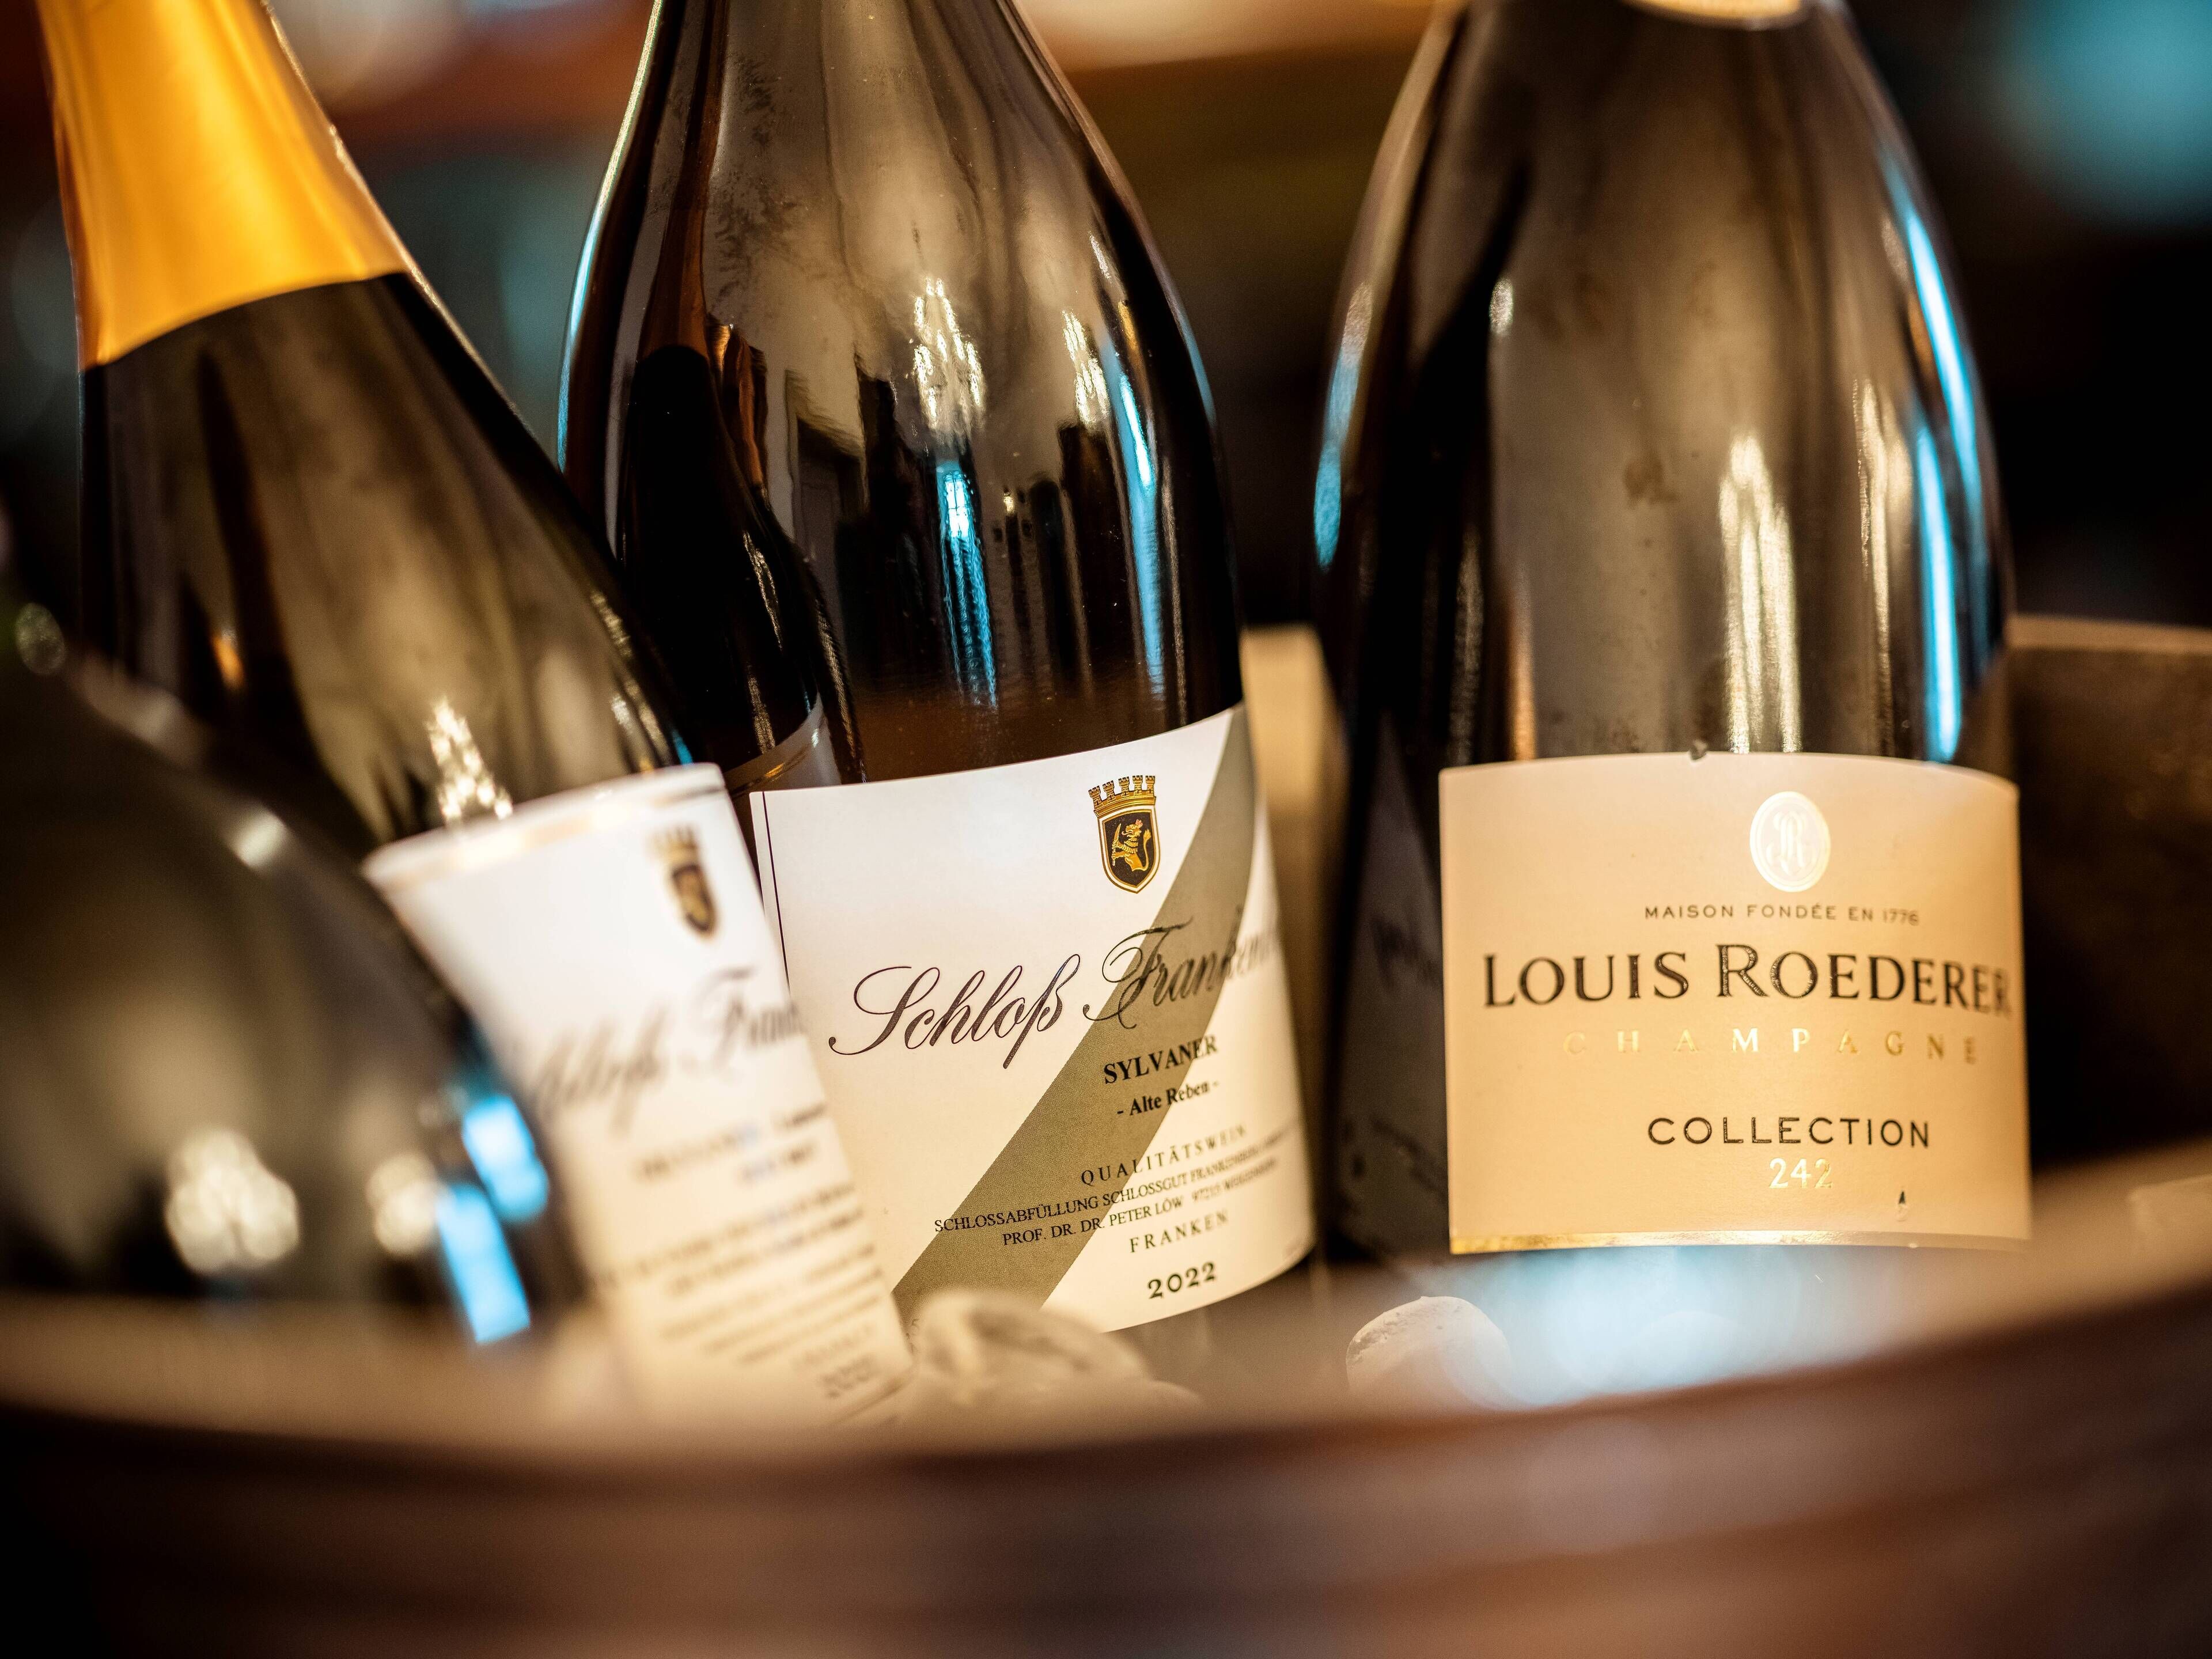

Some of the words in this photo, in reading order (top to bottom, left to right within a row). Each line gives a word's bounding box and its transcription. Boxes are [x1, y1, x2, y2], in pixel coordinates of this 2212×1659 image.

[1645, 904, 1734, 919] MAISON
[1747, 902, 1837, 921] FONDÉE
[1848, 906, 1874, 922] EN
[1881, 908, 1921, 926] 1776
[1483, 951, 1689, 1009] LOUIS
[1717, 944, 2013, 1018] ROEDERER
[828, 954, 1081, 1069] Schloß
[1103, 1035, 1218, 1085] SYLVANER
[1562, 1027, 1979, 1065] CHAMPAGNE
[1129, 1096, 1162, 1116] Alte
[1165, 1081, 1210, 1105] Reben
[1647, 1116, 1929, 1147] COLLECTION
[1080, 1124, 1247, 1187] QUALITÄTSWEIN
[1768, 1157, 1834, 1190] 242
[934, 1195, 1099, 1232] SCHLOSSABFÜLLUNG
[1102, 1172, 1188, 1207] SCHLOSSGUT
[1002, 1227, 1047, 1246] PROF.
[1051, 1223, 1076, 1238] DR.
[1080, 1217, 1105, 1233] DR.
[1109, 1205, 1152, 1226] PETER
[1154, 1195, 1184, 1215] LÖW
[1129, 1208, 1229, 1253] FRANKEN
[1147, 1261, 1216, 1299] 2022
